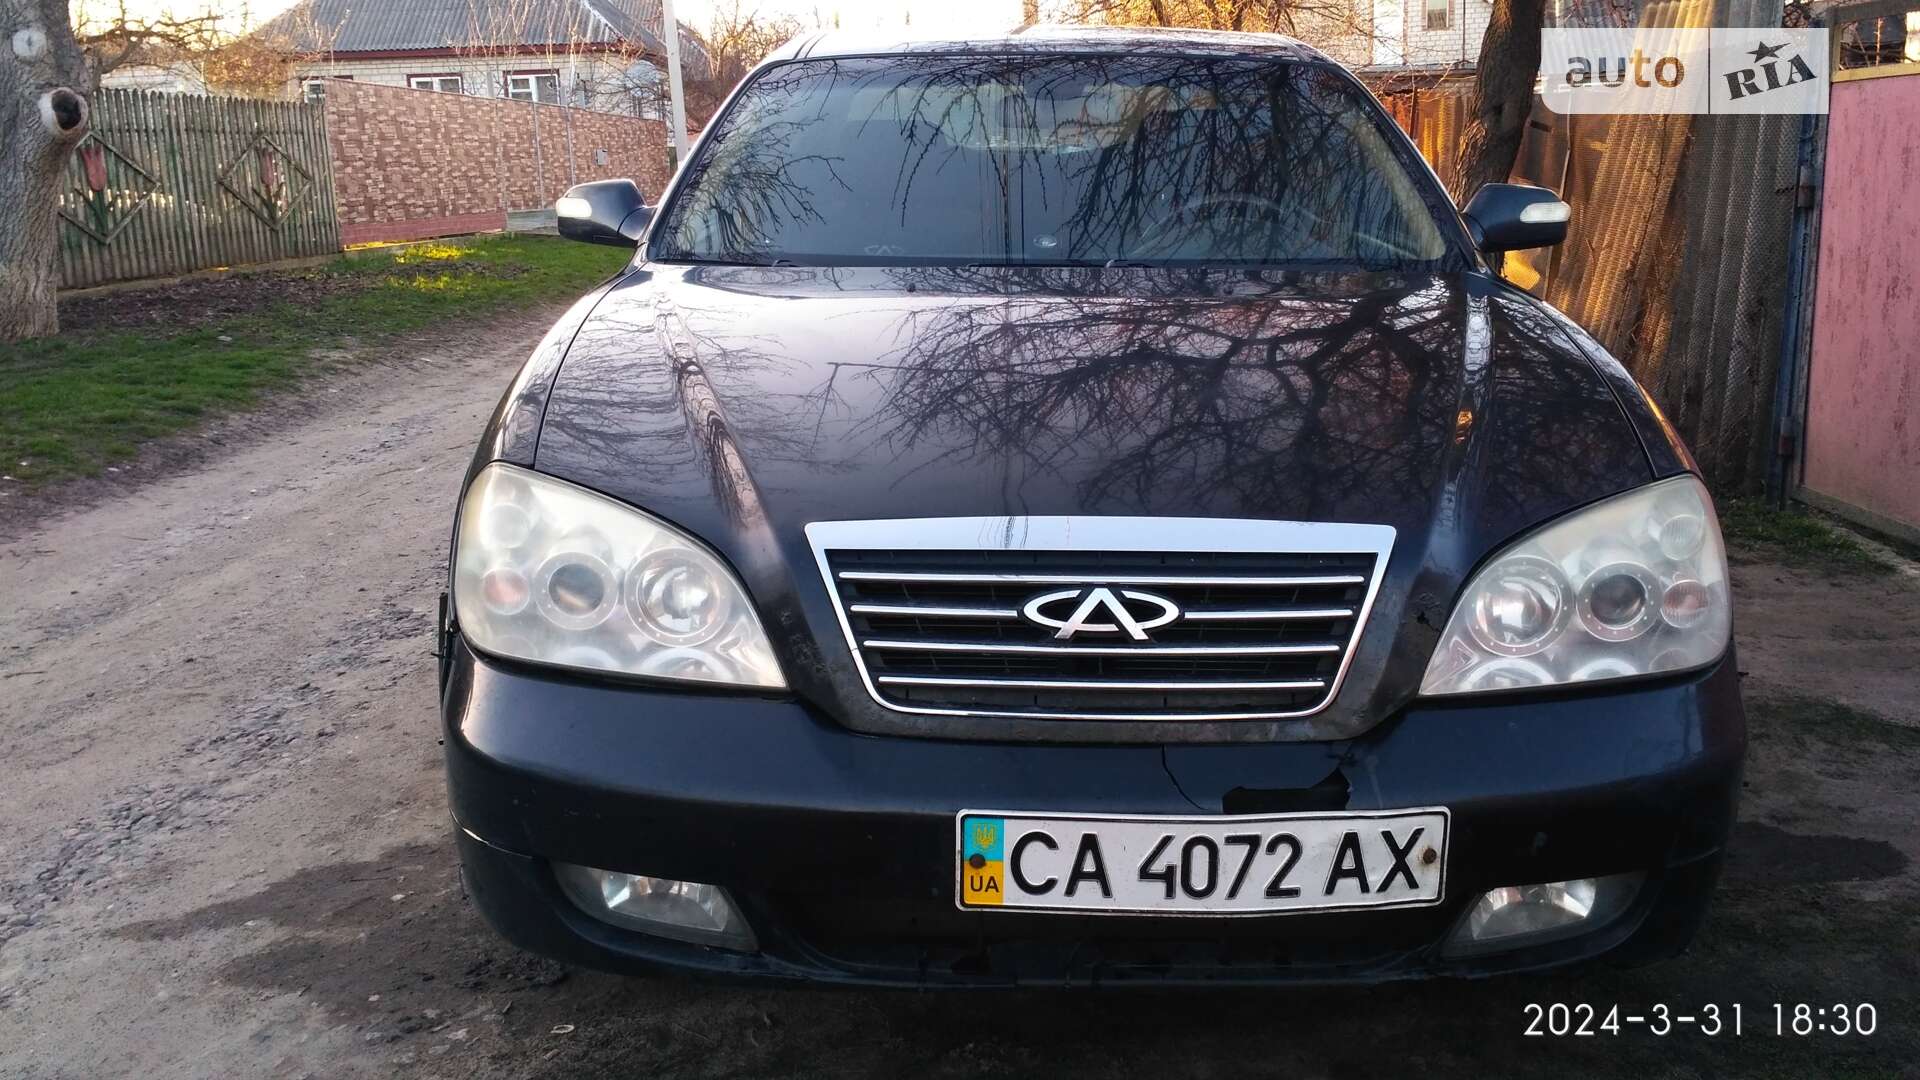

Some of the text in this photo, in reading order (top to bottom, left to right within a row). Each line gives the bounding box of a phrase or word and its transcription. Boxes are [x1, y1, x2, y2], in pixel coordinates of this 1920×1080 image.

[969, 874, 1000, 894] UA
[1010, 827, 1425, 901] CA 4072 AX
